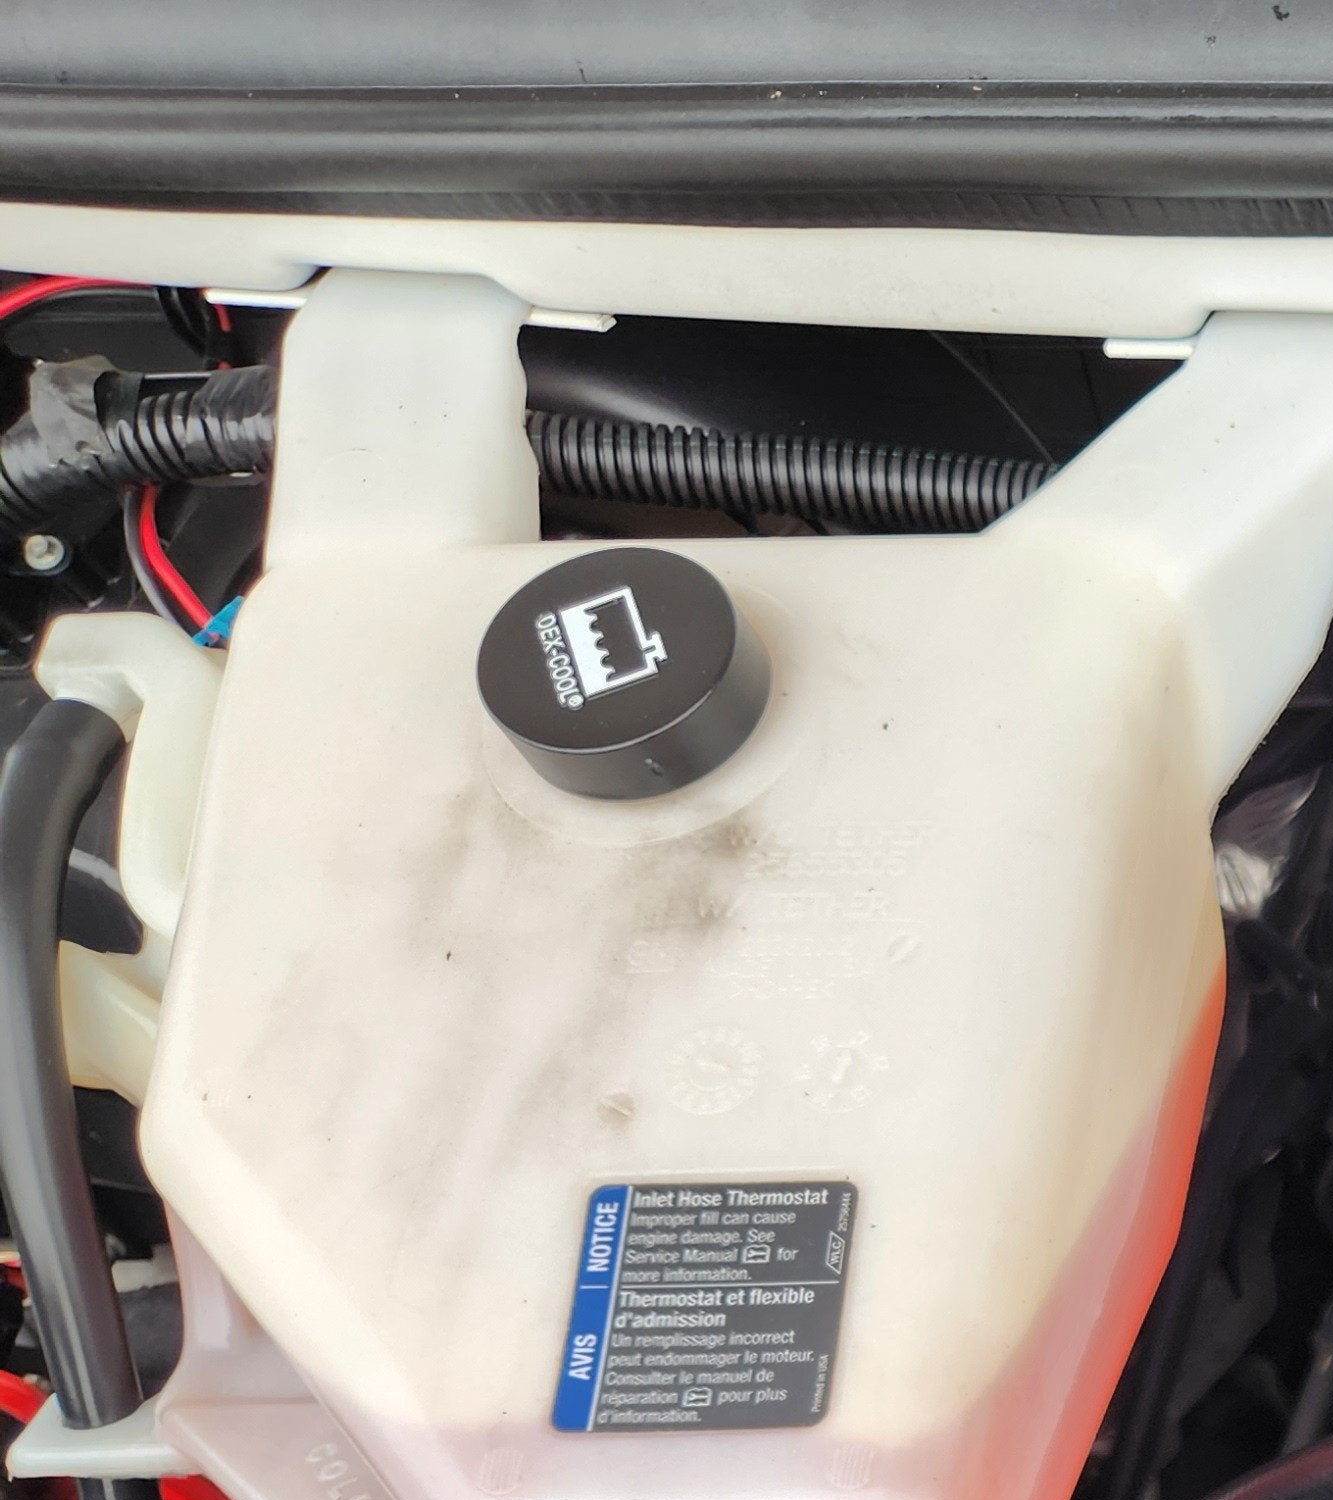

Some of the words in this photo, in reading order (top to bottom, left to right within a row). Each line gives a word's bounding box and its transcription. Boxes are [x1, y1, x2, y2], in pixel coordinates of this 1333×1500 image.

[634, 1191, 673, 1208] Inlet
[678, 1189, 722, 1207] Hose
[727, 1188, 829, 1206] Thermostat
[630, 1211, 695, 1227] Improper
[725, 1212, 749, 1224] can
[753, 1212, 796, 1225] cause
[587, 1202, 618, 1273] NOTICE
[627, 1230, 677, 1247] engine
[681, 1229, 743, 1245] damage.
[746, 1229, 775, 1243] See
[624, 1248, 680, 1264] Service
[685, 1247, 738, 1263] Manual
[777, 1248, 799, 1262] for
[621, 1268, 659, 1283] more
[663, 1266, 751, 1282] information.
[619, 1289, 722, 1308] Thermostat
[727, 1290, 745, 1306] et
[749, 1287, 815, 1305] flexible
[614, 1310, 726, 1329] d'admission
[610, 1333, 632, 1348] Un
[635, 1331, 726, 1350] remplissage
[730, 1329, 795, 1346] incorrect
[569, 1333, 596, 1380] AVIS
[608, 1352, 641, 1368] peut
[647, 1350, 740, 1368] endommager
[744, 1349, 759, 1364] le
[762, 1349, 815, 1364] moteur.
[605, 1371, 675, 1387] Consulter
[679, 1371, 695, 1386] le
[702, 1369, 751, 1384] manuel
[755, 1369, 774, 1383] de
[601, 1389, 678, 1406] réparation
[717, 1391, 753, 1405] pour
[756, 1388, 788, 1403] plus
[597, 1408, 702, 1426] d'information.
